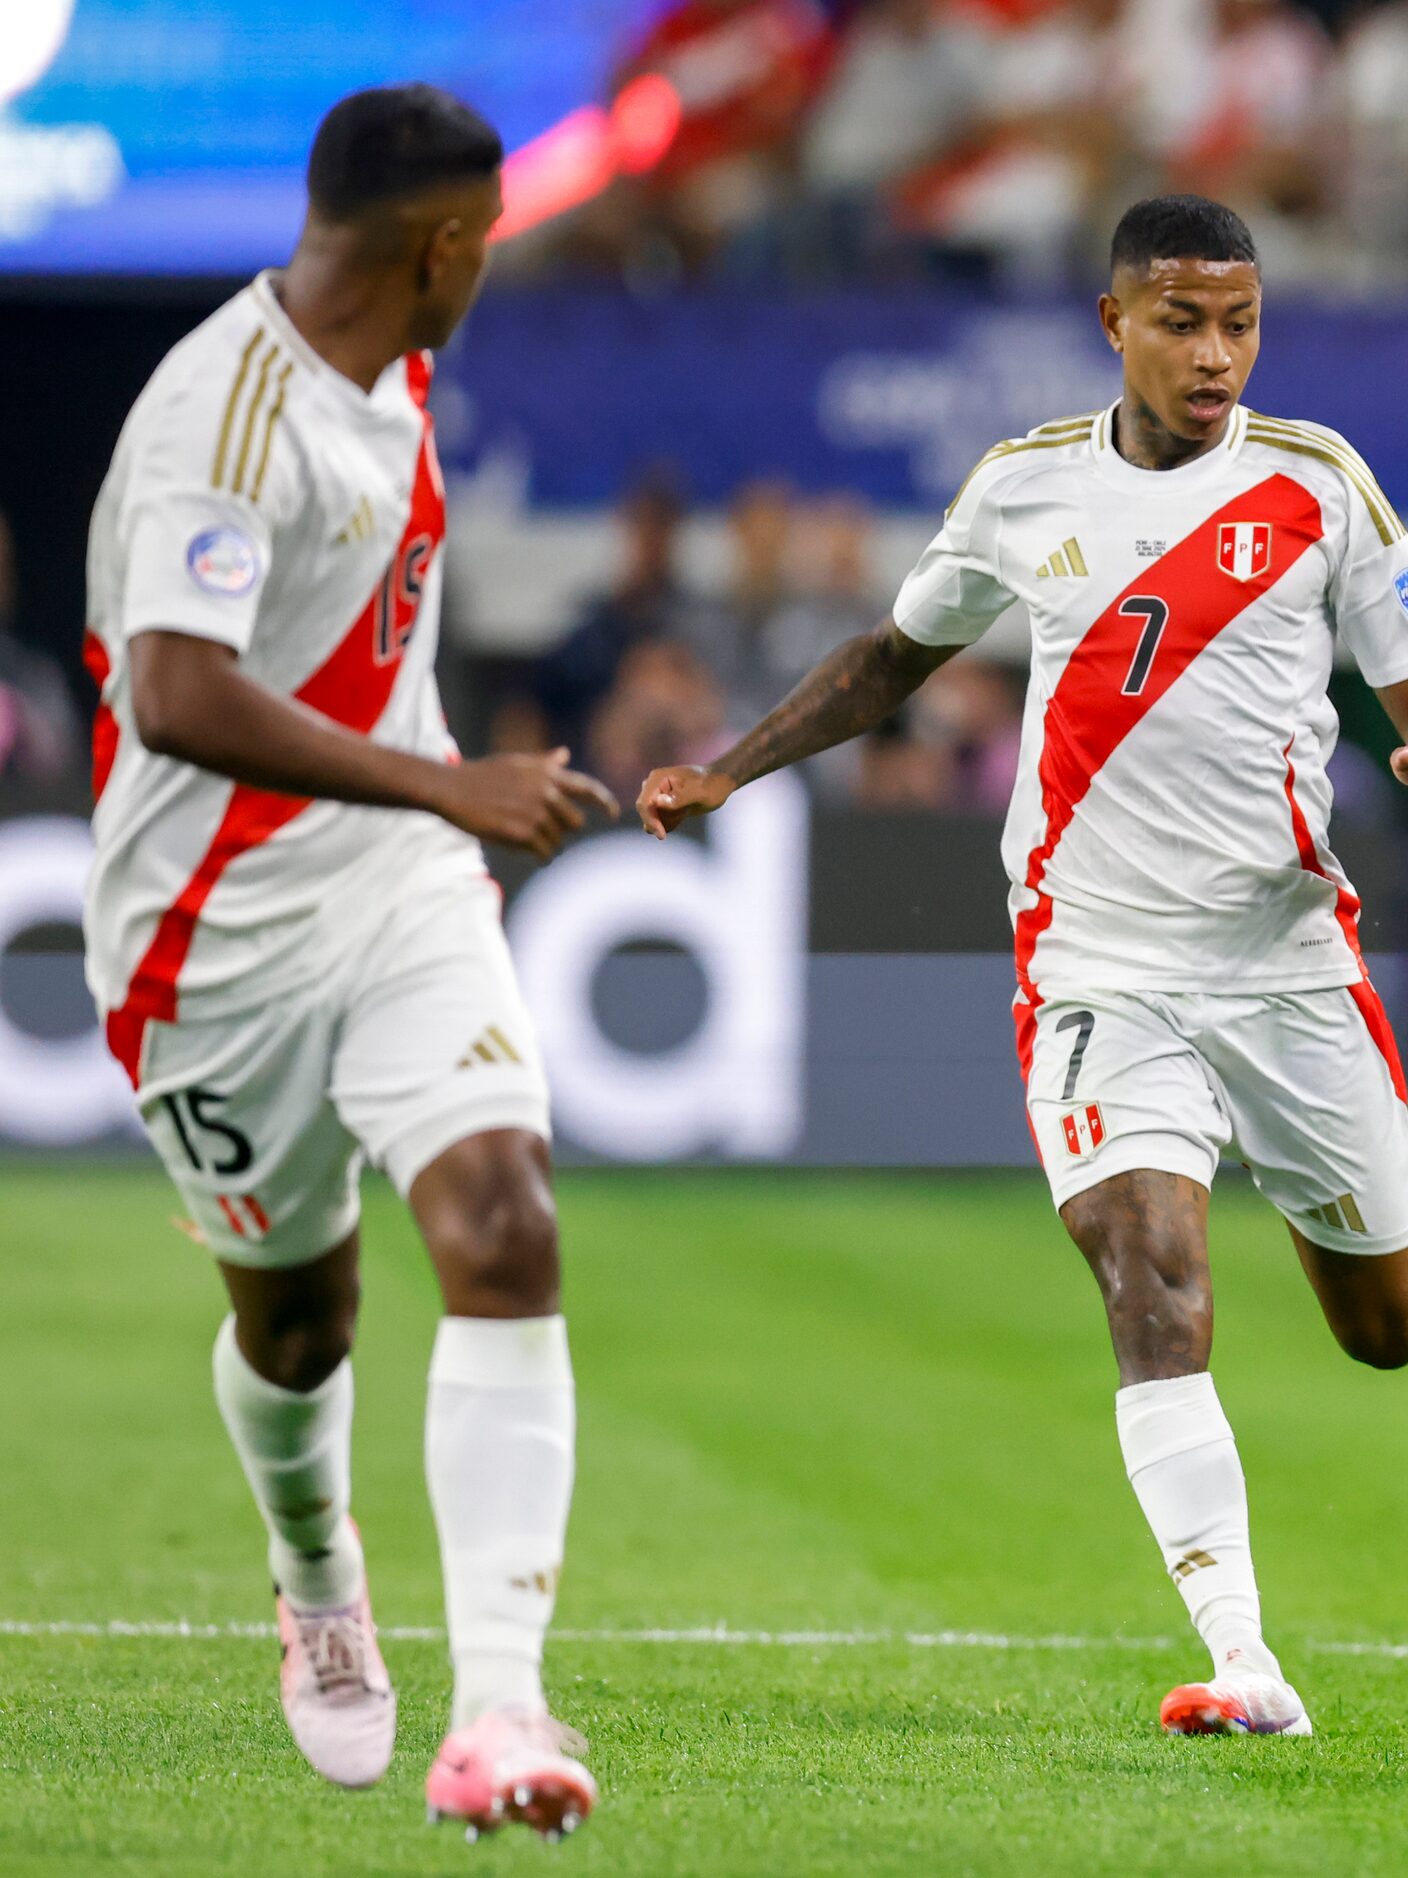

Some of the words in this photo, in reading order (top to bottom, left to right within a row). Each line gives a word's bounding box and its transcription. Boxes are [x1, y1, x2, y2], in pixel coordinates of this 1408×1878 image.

[374, 533, 432, 667] 15
[1118, 594, 1170, 696] 7
[1055, 1010, 1095, 1100] 7
[160, 1087, 254, 1175] 15
